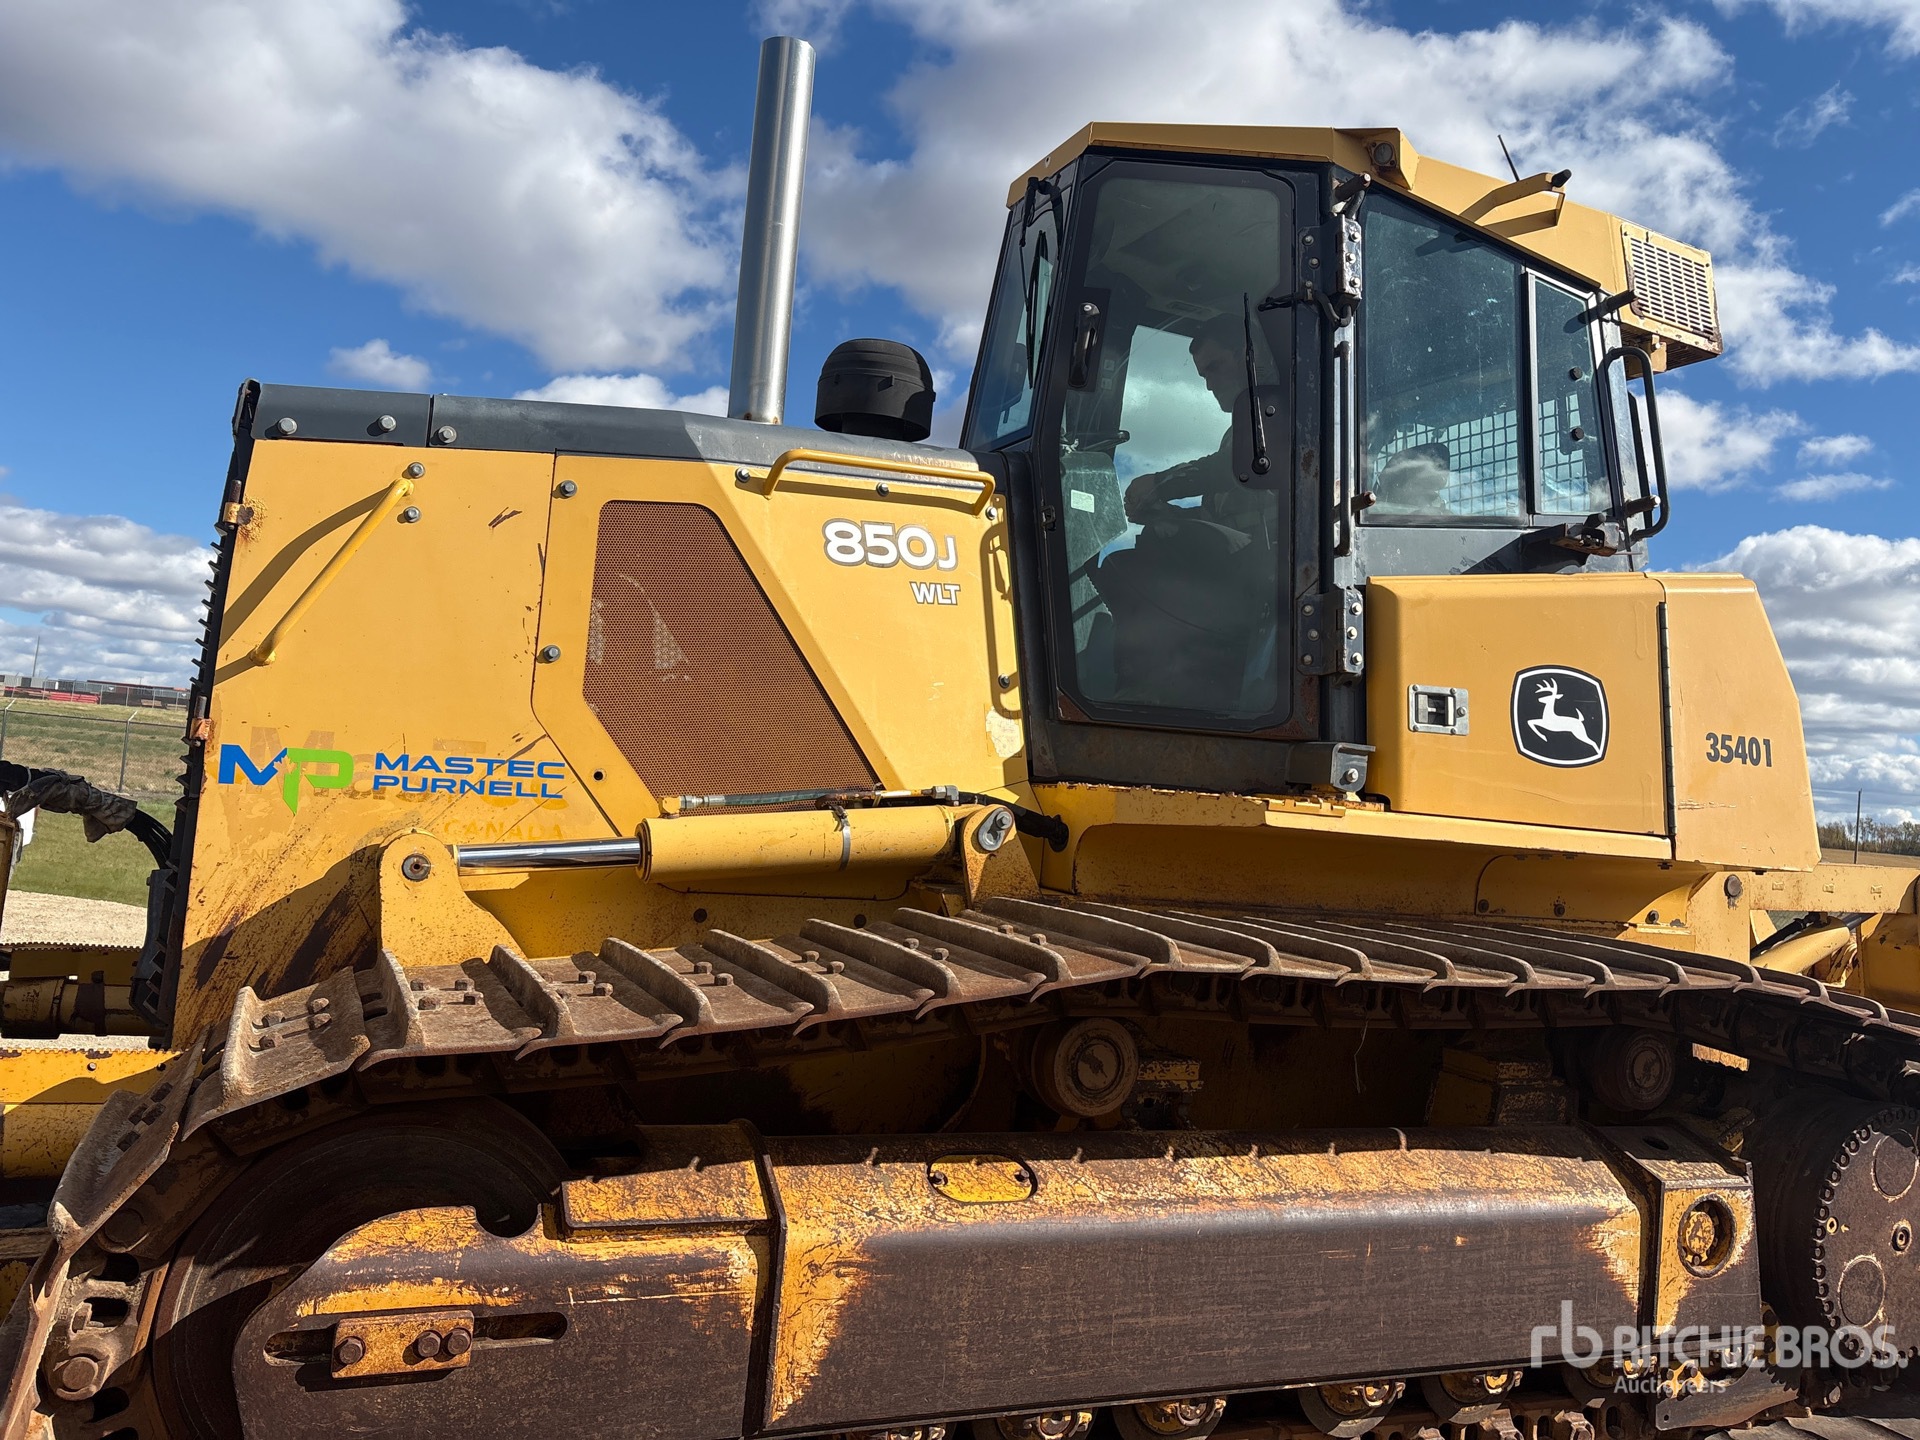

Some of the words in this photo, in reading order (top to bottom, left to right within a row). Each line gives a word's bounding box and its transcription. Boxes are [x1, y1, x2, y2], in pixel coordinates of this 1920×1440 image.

[822, 518, 959, 571] 850J
[909, 581, 961, 606] WLT
[1705, 732, 1772, 767] 35401
[374, 752, 566, 780] MASTEC
[372, 774, 564, 799] PURNELL
